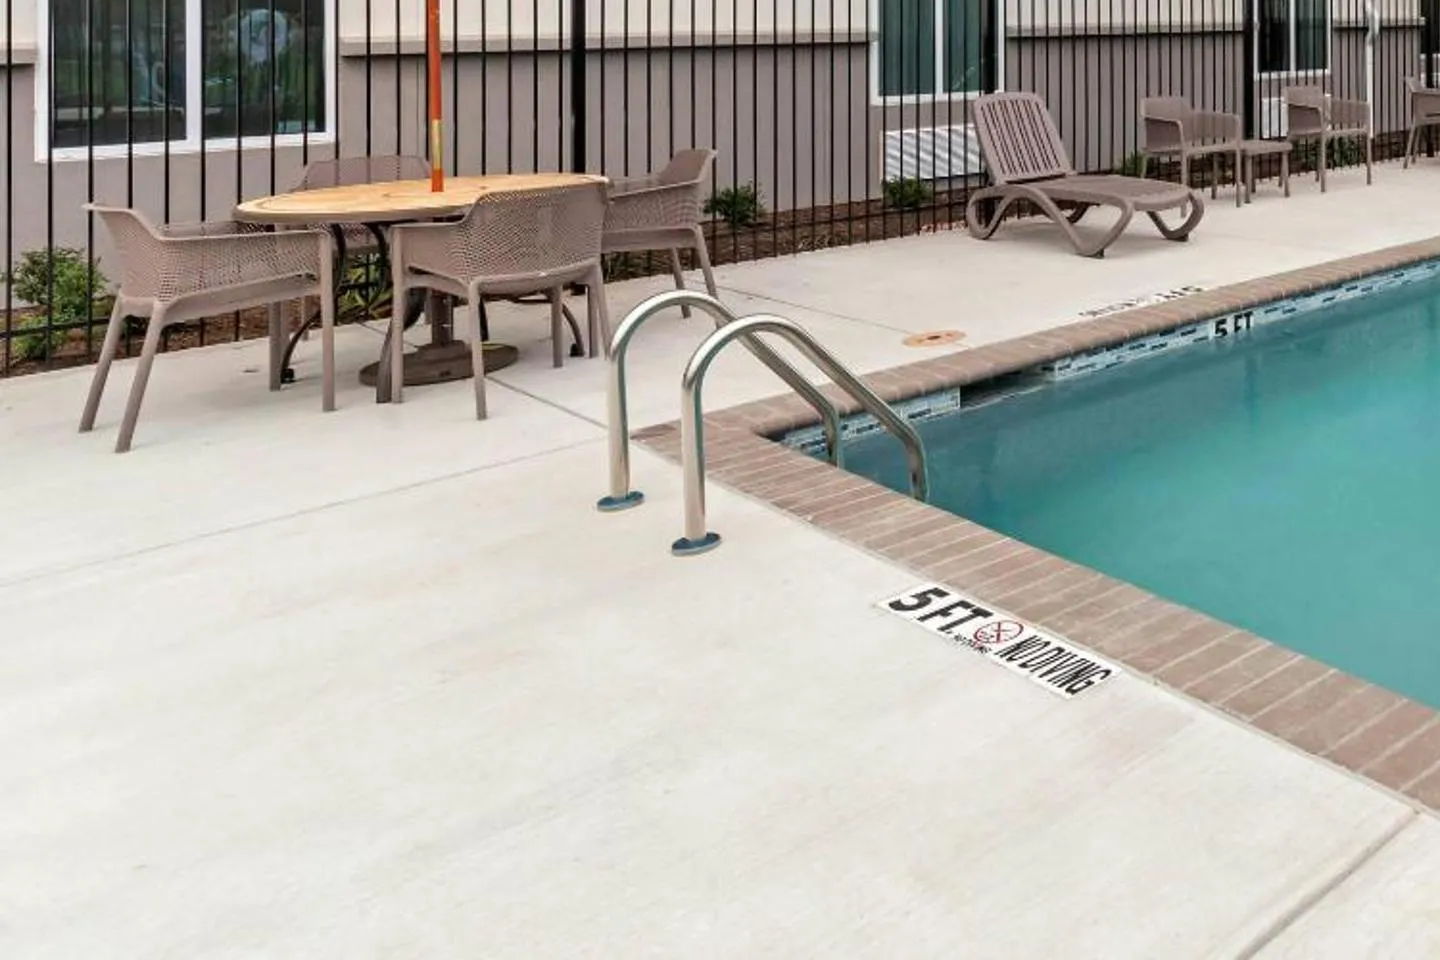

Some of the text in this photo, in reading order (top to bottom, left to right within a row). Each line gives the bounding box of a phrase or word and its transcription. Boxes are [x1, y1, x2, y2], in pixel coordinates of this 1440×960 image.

[1214, 311, 1254, 337] 5 FT
[888, 586, 950, 612] 5
[994, 634, 1112, 696] NO DIVING
